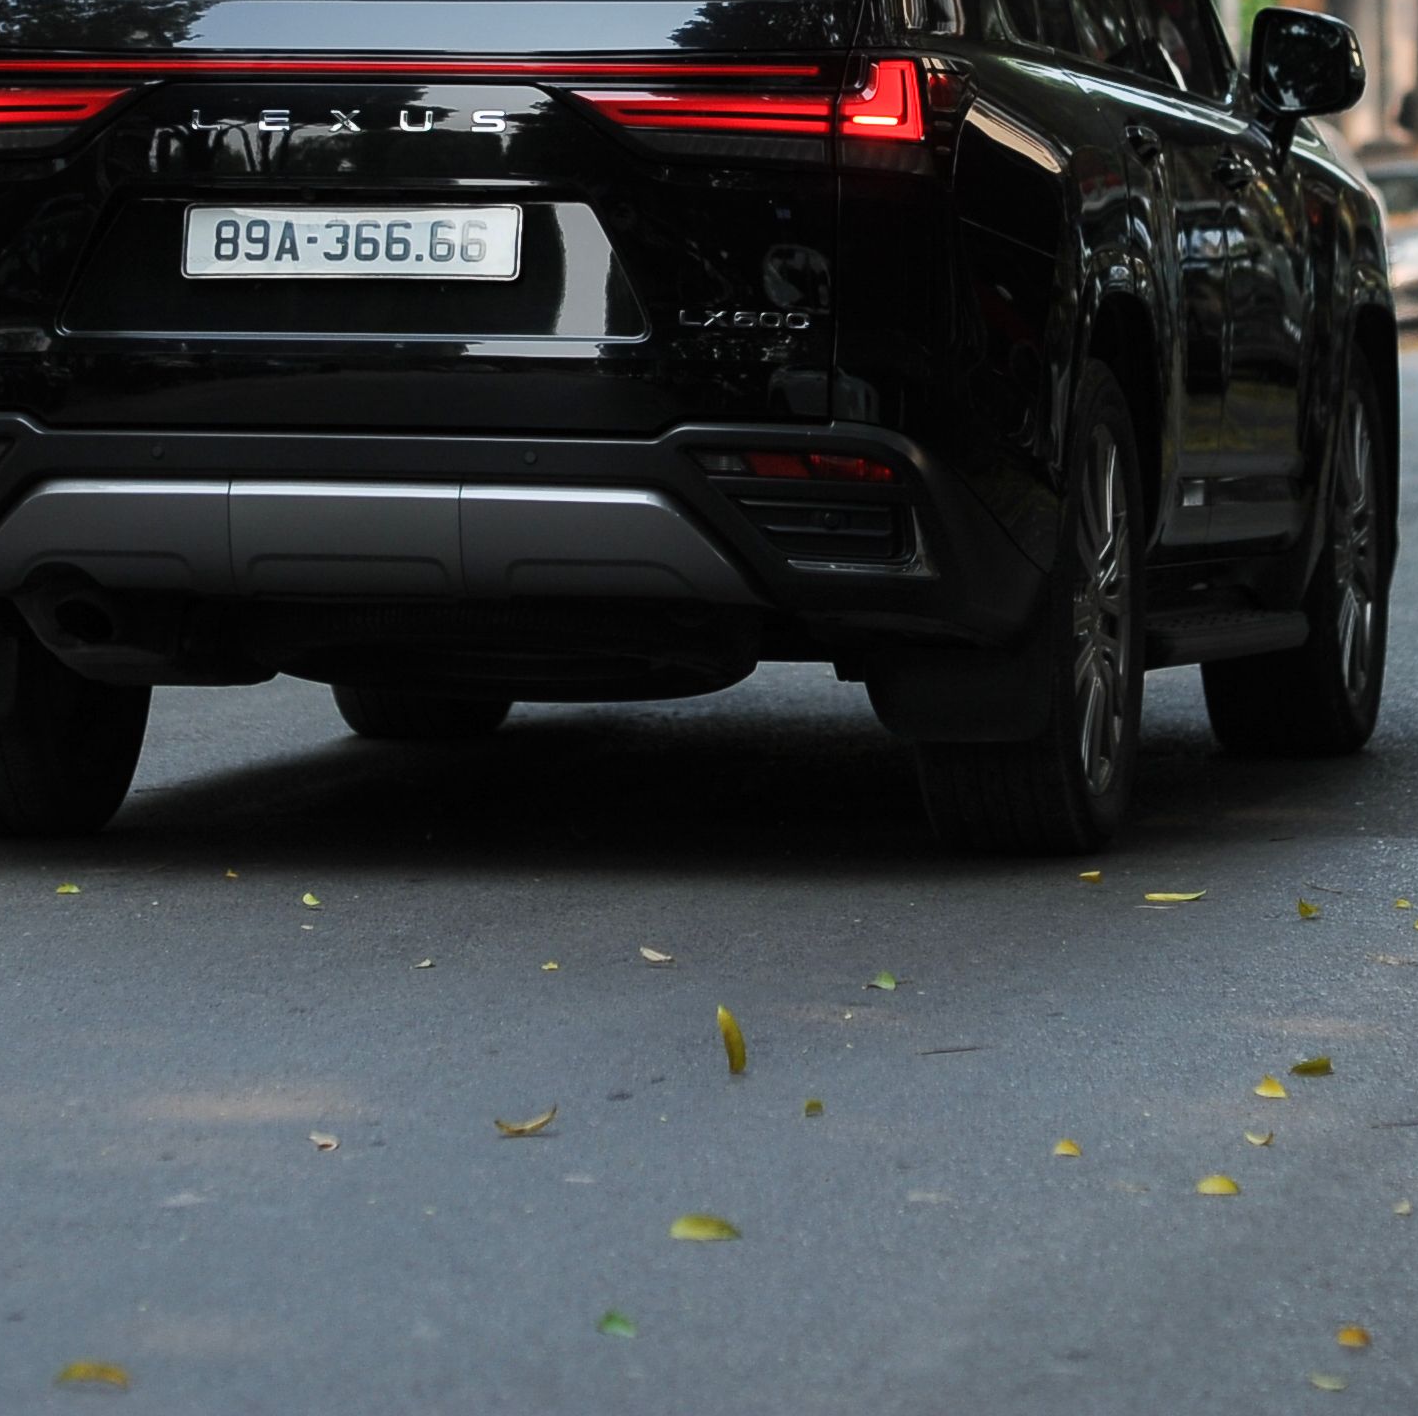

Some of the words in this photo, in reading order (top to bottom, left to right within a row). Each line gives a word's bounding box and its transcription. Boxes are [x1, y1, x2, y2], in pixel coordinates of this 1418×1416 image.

[190, 109, 508, 133] LEXUS
[213, 219, 488, 263] 89A-366.66
[679, 309, 811, 330] LX600
